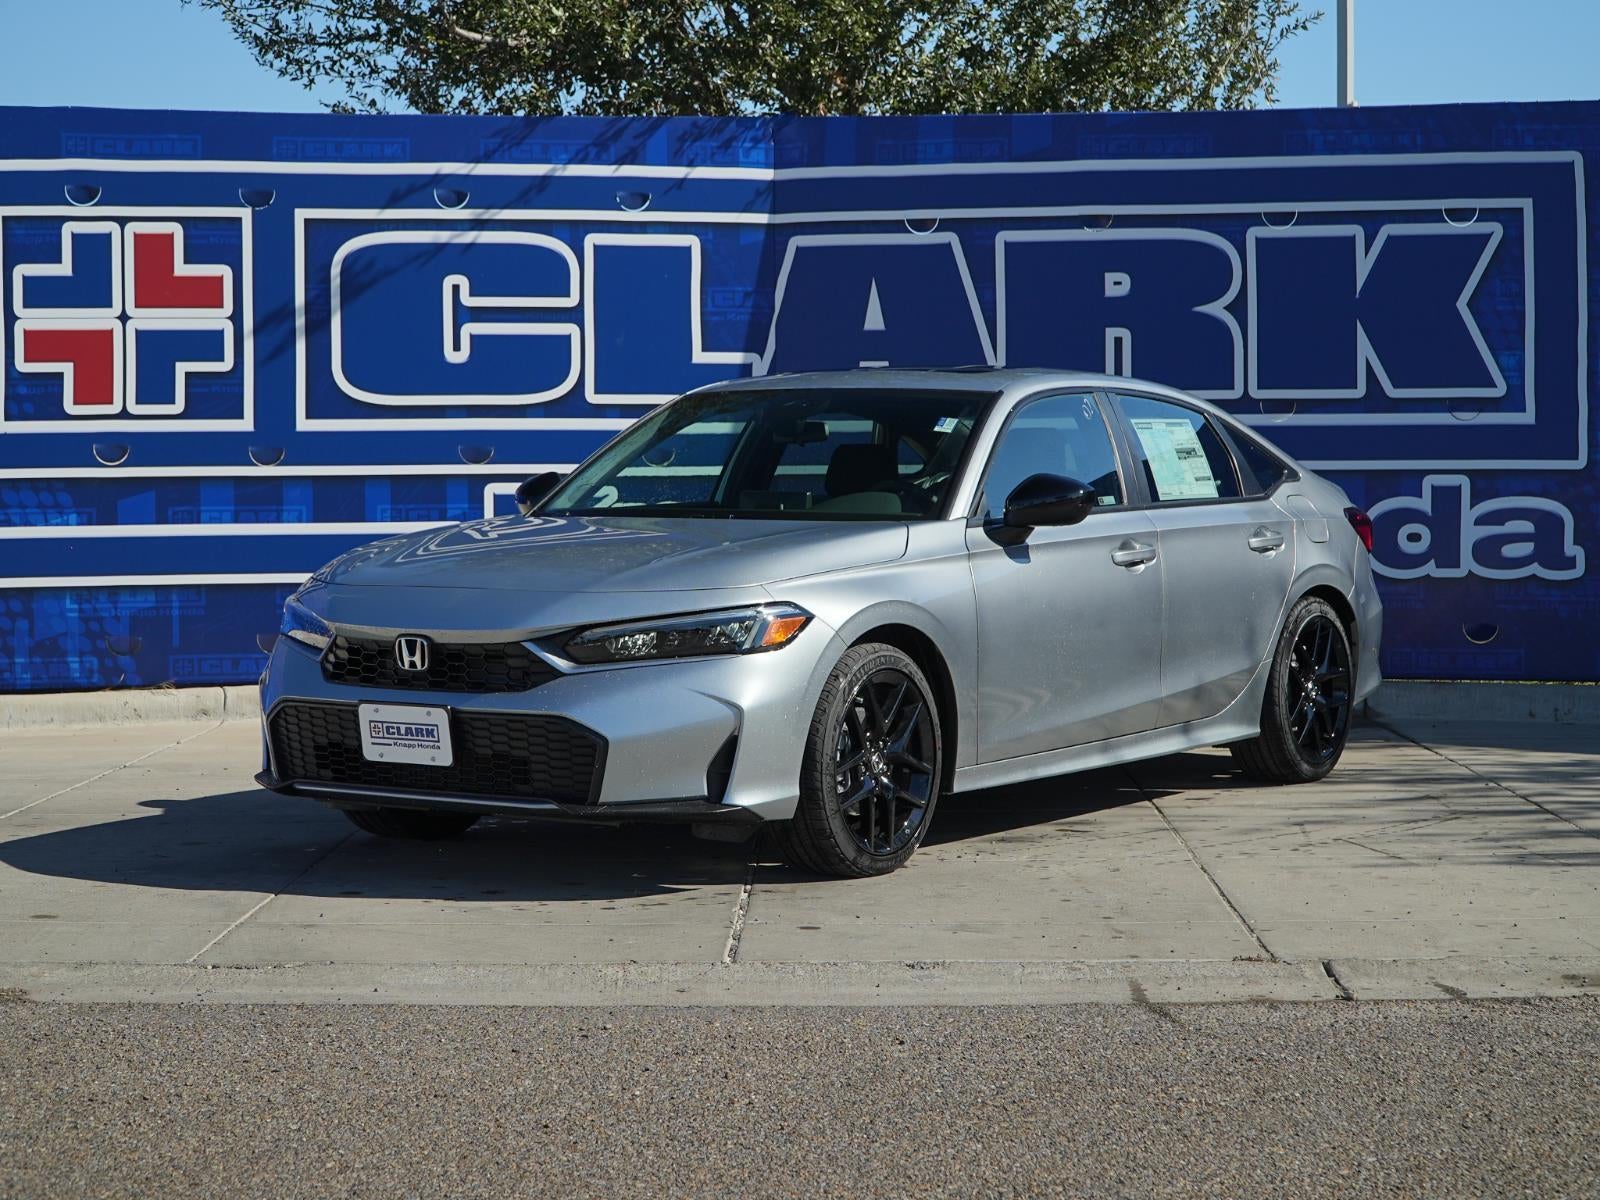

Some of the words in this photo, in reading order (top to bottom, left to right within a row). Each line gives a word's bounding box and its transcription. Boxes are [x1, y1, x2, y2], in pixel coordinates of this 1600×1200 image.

[329, 222, 1507, 407] CLARK
[385, 725, 436, 739] CLARK
[393, 741, 416, 749] Knapp
